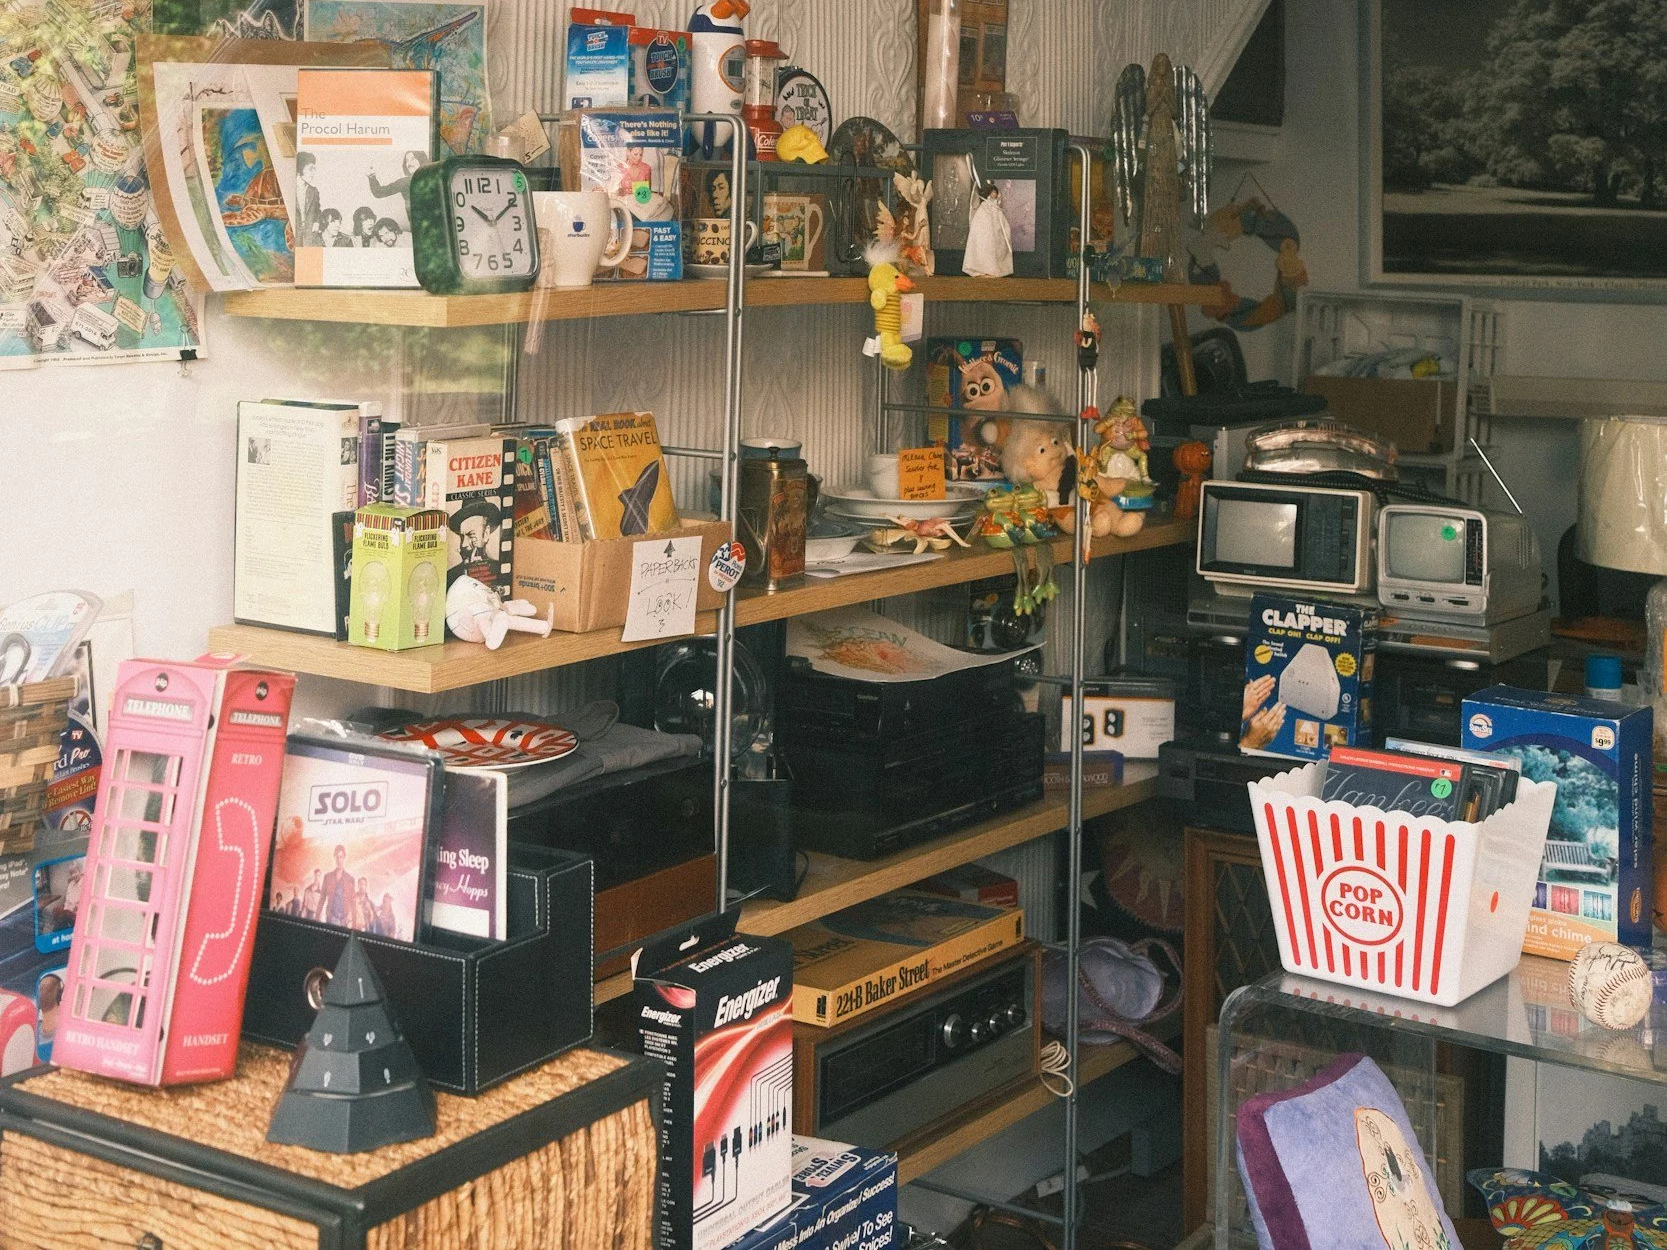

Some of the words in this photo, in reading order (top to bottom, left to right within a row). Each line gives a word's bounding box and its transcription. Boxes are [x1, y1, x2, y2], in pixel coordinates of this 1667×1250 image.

[302, 108, 326, 120] The
[301, 122, 342, 136] Procol
[346, 122, 390, 136] Harum
[620, 120, 648, 129] There's
[649, 120, 677, 130] Nothing
[661, 129, 669, 137] it!
[464, 178, 473, 194] 11
[477, 177, 492, 194] 12
[507, 192, 518, 207] 2
[456, 216, 465, 233] 9
[512, 216, 522, 231] 3
[653, 227, 671, 235] FAST
[513, 238, 524, 254] 4
[659, 234, 676, 242] EASY
[459, 240, 469, 255] 8
[473, 253, 483, 269] 7
[488, 255, 499, 270] 6
[503, 253, 513, 268] 5
[580, 435, 614, 451] SPACE
[616, 431, 657, 448] TRAVEL
[450, 453, 502, 472] CITIZEN
[456, 472, 494, 488] KANE
[451, 492, 475, 501] CLASSIC
[477, 490, 497, 498] SERIES
[363, 540, 377, 549] FLAME
[377, 541, 389, 550] BULB
[364, 532, 389, 542] FLICKERING
[412, 542, 427, 550] FLAME
[427, 540, 438, 549] BULB
[413, 533, 438, 542] FLICKERING
[714, 560, 740, 579] PEROT
[1296, 603, 1316, 616] THE
[1262, 608, 1347, 637] CLAPPER
[1268, 627, 1286, 636] CLAP
[1287, 630, 1302, 639] ON!
[1306, 633, 1324, 642] CLAP
[1325, 635, 1341, 644] OFF!
[127, 699, 192, 719] TELEPHONE
[233, 712, 282, 726] TELEPHONE
[72, 730, 83, 740] TV
[70, 748, 91, 765] Pro
[231, 753, 263, 765] RETRO
[53, 780, 80, 797] Easiest
[81, 775, 95, 789] Way
[48, 792, 78, 809] Remove
[314, 788, 382, 815] SOLO
[323, 818, 343, 826] STAR
[345, 817, 367, 825] WARS
[459, 848, 489, 875] Sleep
[450, 874, 489, 901] Hopps
[1340, 882, 1383, 904] POP
[1329, 900, 1394, 928] CORN
[1551, 926, 1592, 944] chime
[688, 942, 751, 974] Energizer
[836, 985, 862, 1018] 221-B
[865, 975, 897, 1006] Baker
[898, 958, 930, 991] Street
[931, 966, 942, 976] The
[942, 957, 962, 973] Master
[962, 945, 987, 964] Detective
[987, 940, 1004, 952] Game
[713, 975, 782, 1029] Energizer
[640, 1005, 682, 1025] Energizer
[65, 1030, 95, 1045] RETRO
[96, 1034, 140, 1054] HANDSET
[182, 1033, 229, 1048] HANDSET
[798, 1221, 815, 1246] Into
[814, 1216, 826, 1234] An
[827, 1191, 863, 1227] Organized
[862, 1170, 896, 1202] Success!
[862, 1219, 875, 1237] To
[875, 1210, 894, 1231] See
